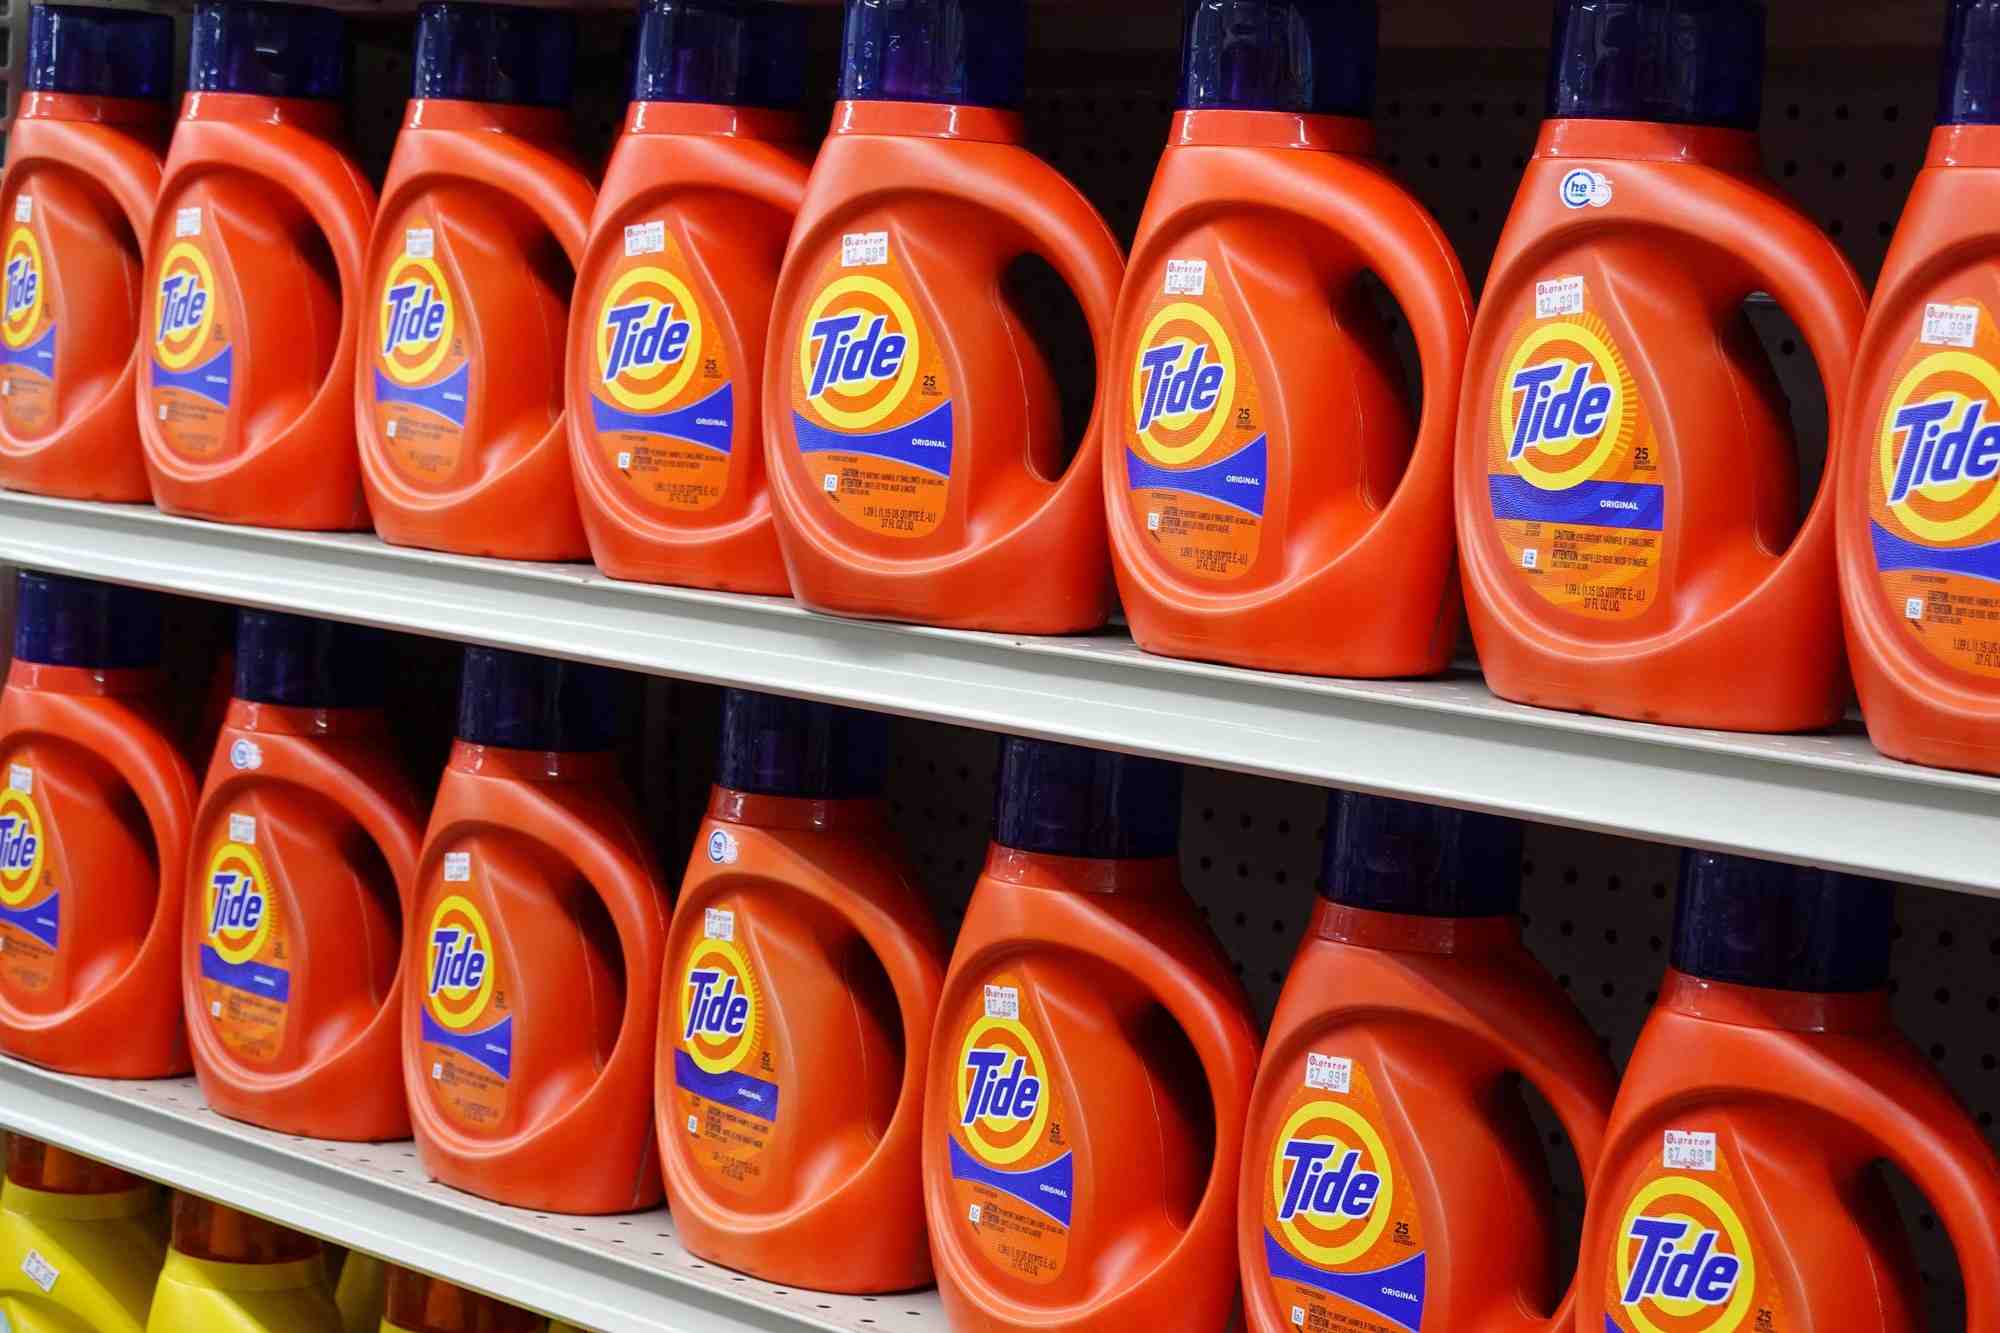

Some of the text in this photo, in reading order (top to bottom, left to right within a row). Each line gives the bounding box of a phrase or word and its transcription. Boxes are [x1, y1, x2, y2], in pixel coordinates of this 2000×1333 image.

[1570, 180, 1588, 193] he
[4, 258, 37, 323] Tide
[158, 274, 208, 342] Tide
[384, 285, 445, 354] Tide
[605, 303, 691, 380] Tide
[808, 315, 907, 398] Tide
[923, 375, 936, 386] 25
[1138, 344, 1225, 431] Tide
[1509, 364, 1613, 459] Tide
[911, 437, 947, 449] ORIGINAL
[1238, 408, 1250, 420] 25
[1225, 474, 1260, 486] ORIGINAL
[1634, 448, 1649, 460] 25
[1890, 400, 2000, 502] Tide
[1599, 499, 1639, 511] ORIGINAL
[210, 874, 262, 934] Tide
[431, 930, 485, 995] Tide
[685, 970, 749, 1039] Tide
[963, 1051, 1040, 1124] Tide
[1040, 1183, 1068, 1199] ORIGINAL
[1279, 1140, 1380, 1220] Tide
[1395, 1222, 1409, 1235] 25
[1623, 1218, 1739, 1303] Tide
[1381, 1287, 1419, 1303] ORIGINAL
[1756, 1309, 1772, 1322] 25
